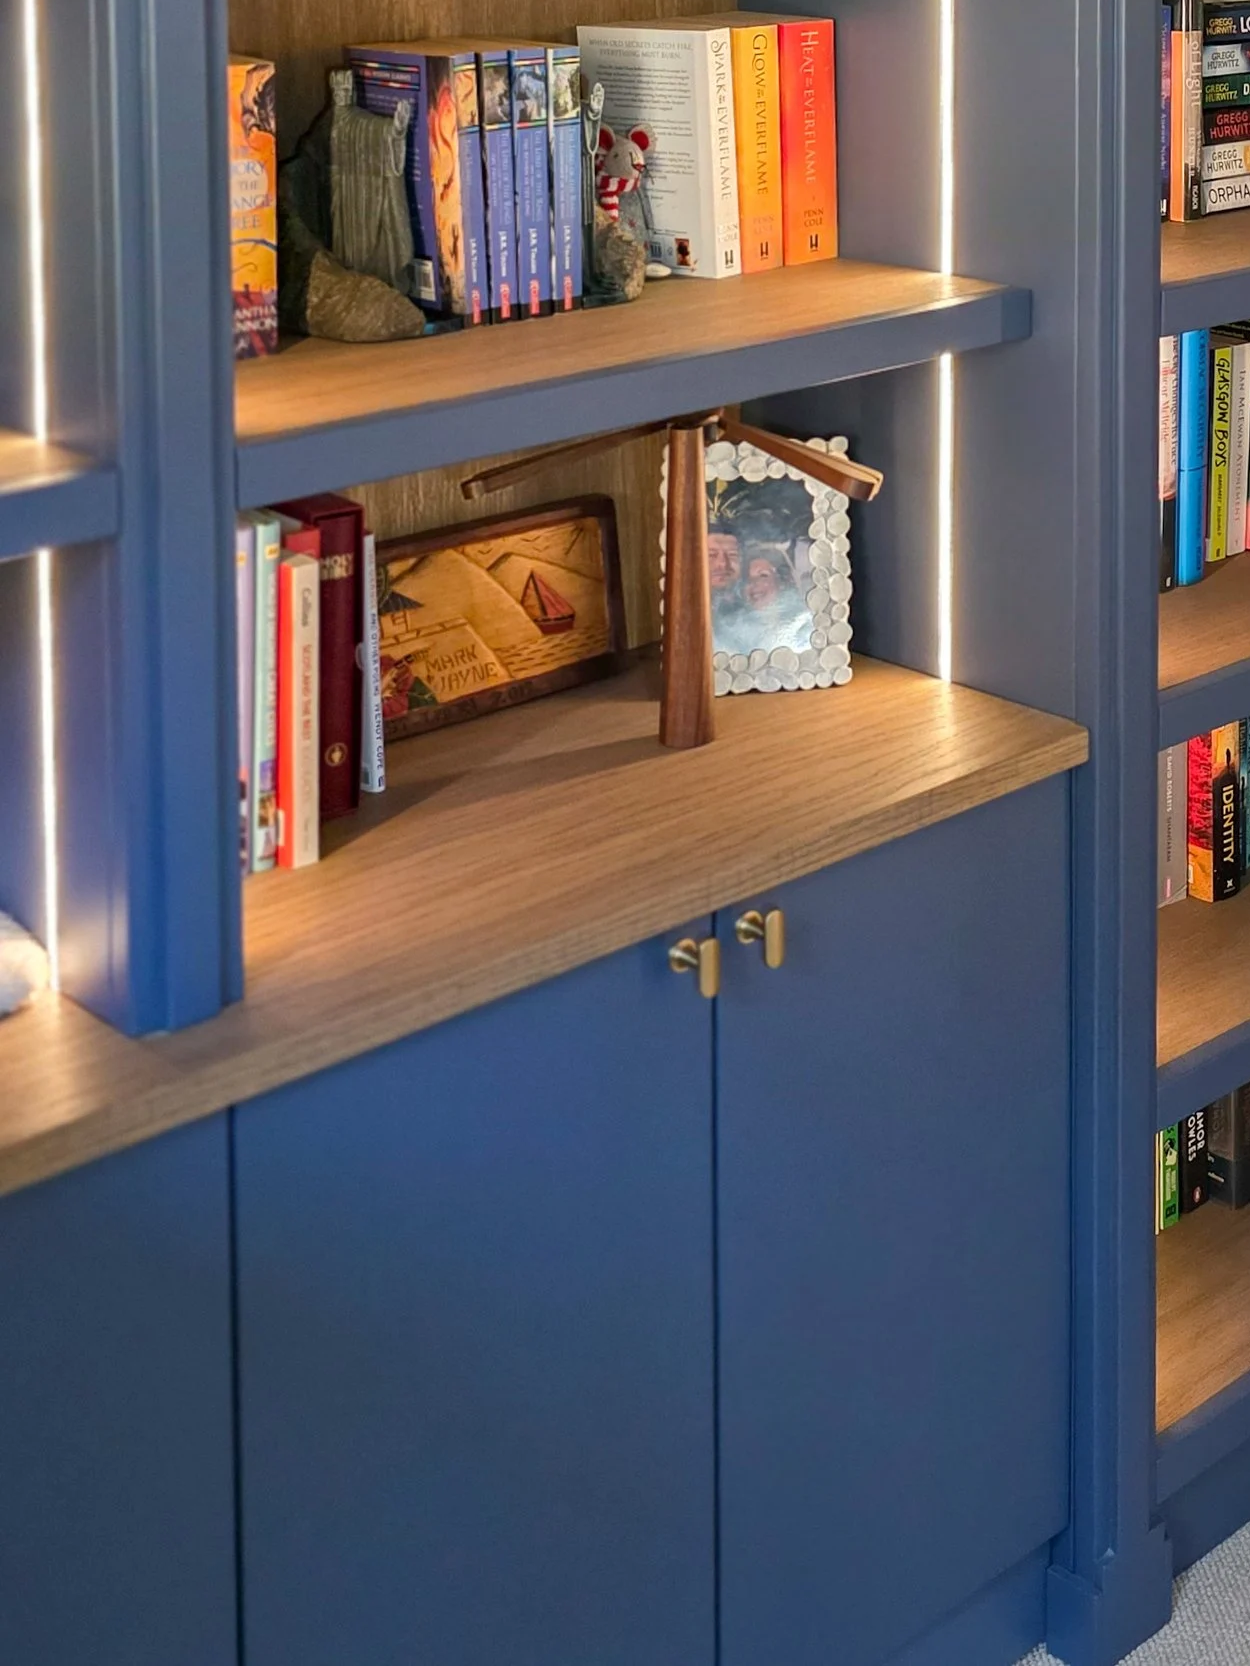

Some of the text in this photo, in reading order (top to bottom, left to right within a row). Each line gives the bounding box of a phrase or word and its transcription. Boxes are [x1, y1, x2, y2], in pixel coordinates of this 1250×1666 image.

[801, 30, 820, 77] HEAT
[424, 644, 480, 673] MARK
[436, 662, 501, 693] JAYNE
[1221, 784, 1234, 864] IDENTITY
